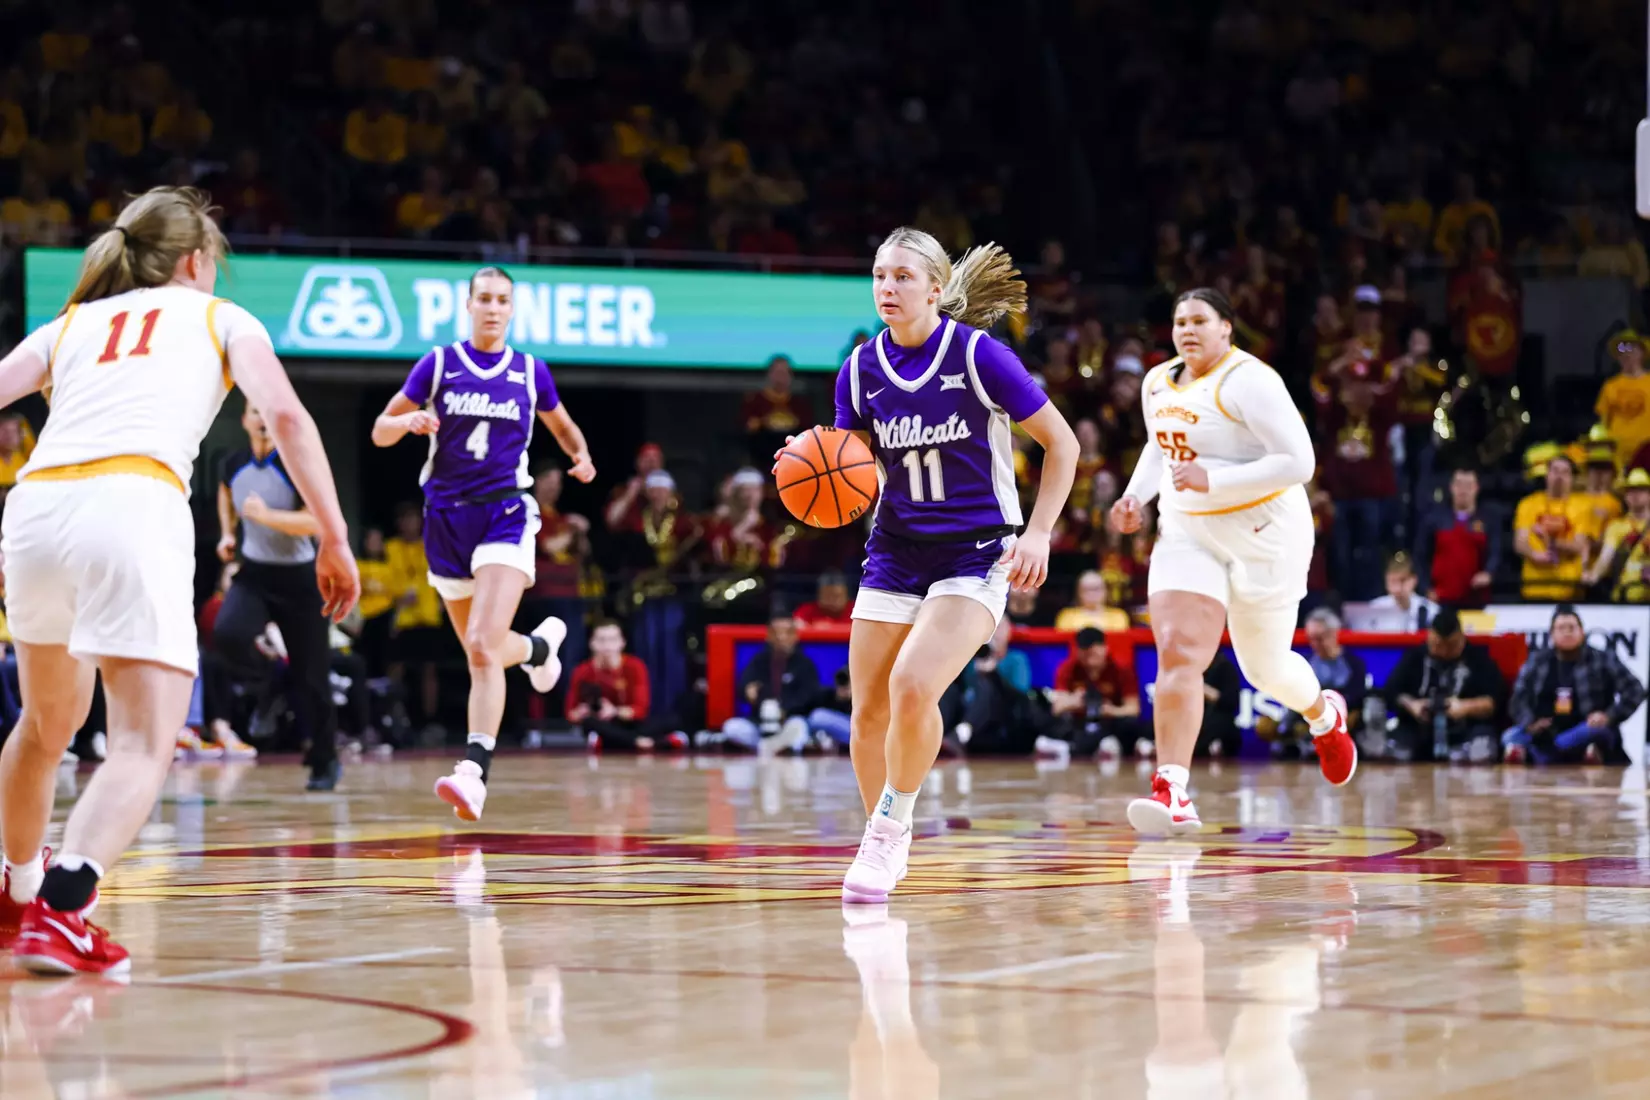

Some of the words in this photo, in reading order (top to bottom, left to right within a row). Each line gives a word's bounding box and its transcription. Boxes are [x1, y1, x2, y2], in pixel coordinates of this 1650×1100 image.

[413, 278, 656, 346] PINEER
[97, 308, 162, 364] 11
[443, 391, 521, 421] Wildcats
[466, 421, 490, 460] 4
[873, 412, 972, 449] Wildcats
[902, 448, 946, 502] 11
